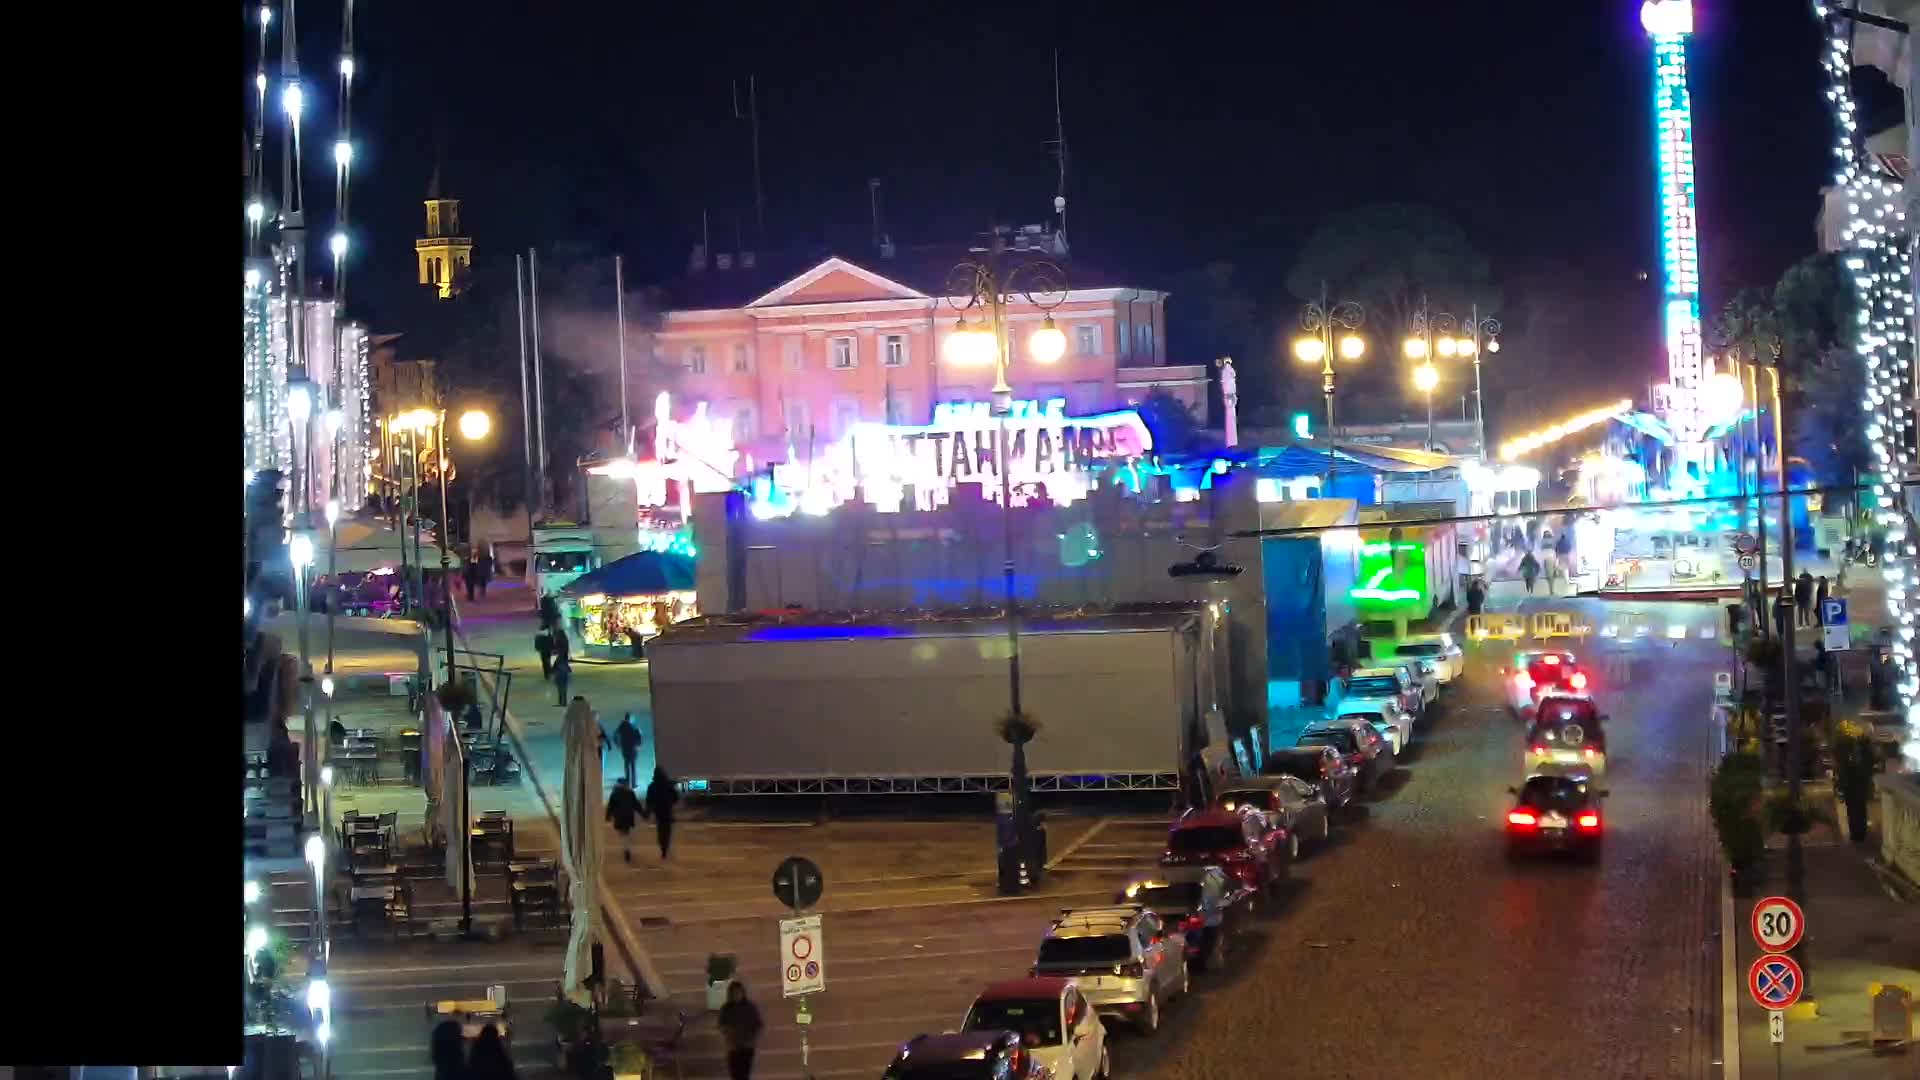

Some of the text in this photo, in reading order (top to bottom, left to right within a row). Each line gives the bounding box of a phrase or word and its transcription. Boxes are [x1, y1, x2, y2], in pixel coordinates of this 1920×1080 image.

[1743, 558, 1753, 567] 20
[1825, 602, 1842, 623] P
[1763, 912, 1791, 937] 30
